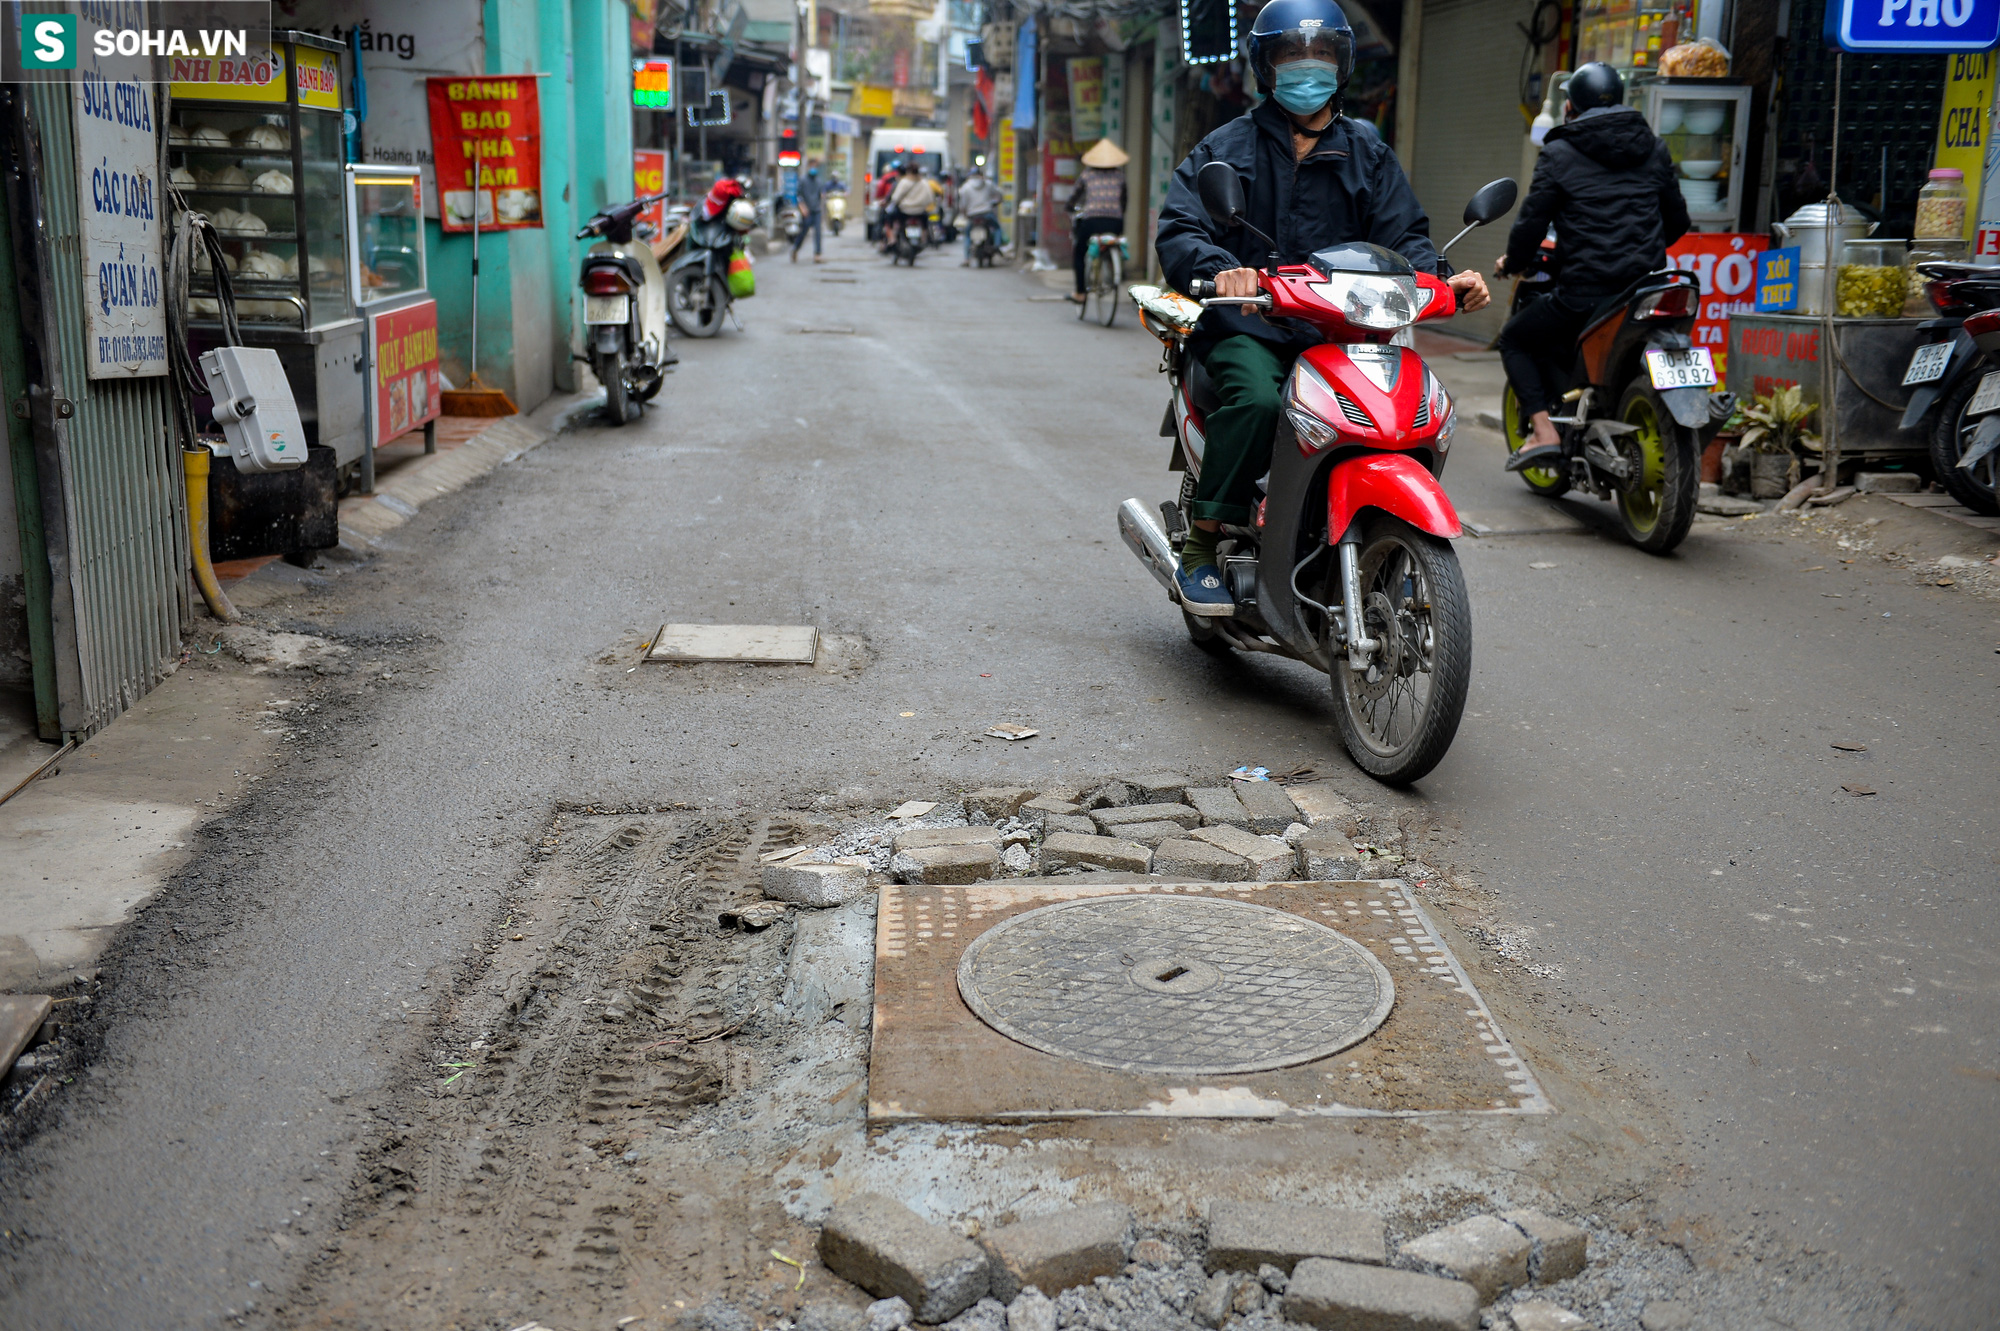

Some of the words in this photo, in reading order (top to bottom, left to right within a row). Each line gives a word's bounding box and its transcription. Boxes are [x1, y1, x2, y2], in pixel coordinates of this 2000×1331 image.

[1299, 19, 1324, 27] GRS
[218, 60, 272, 84] BAO
[298, 59, 319, 90] BÁNH
[320, 69, 335, 93] BAO
[448, 79, 518, 100] BÁNH
[115, 74, 152, 132] CHỮA
[461, 111, 511, 129] BAO
[1945, 90, 1981, 148] CHẢ
[373, 147, 412, 165] Hoàng
[416, 150, 434, 164] Ma
[462, 136, 515, 158] NHÀ
[465, 165, 518, 186] LÀM
[93, 156, 120, 214] CÁC
[122, 173, 154, 231] LOẠI
[1765, 254, 1791, 280] XÔI
[99, 242, 137, 316] QUẦN
[141, 254, 158, 307] ÁO
[1761, 282, 1794, 306] THỊT
[1786, 328, 1819, 363] QUÊ
[1658, 351, 1702, 368] 90-B2
[1656, 367, 1712, 387] 639.92
[1906, 362, 1943, 383] 289.66
